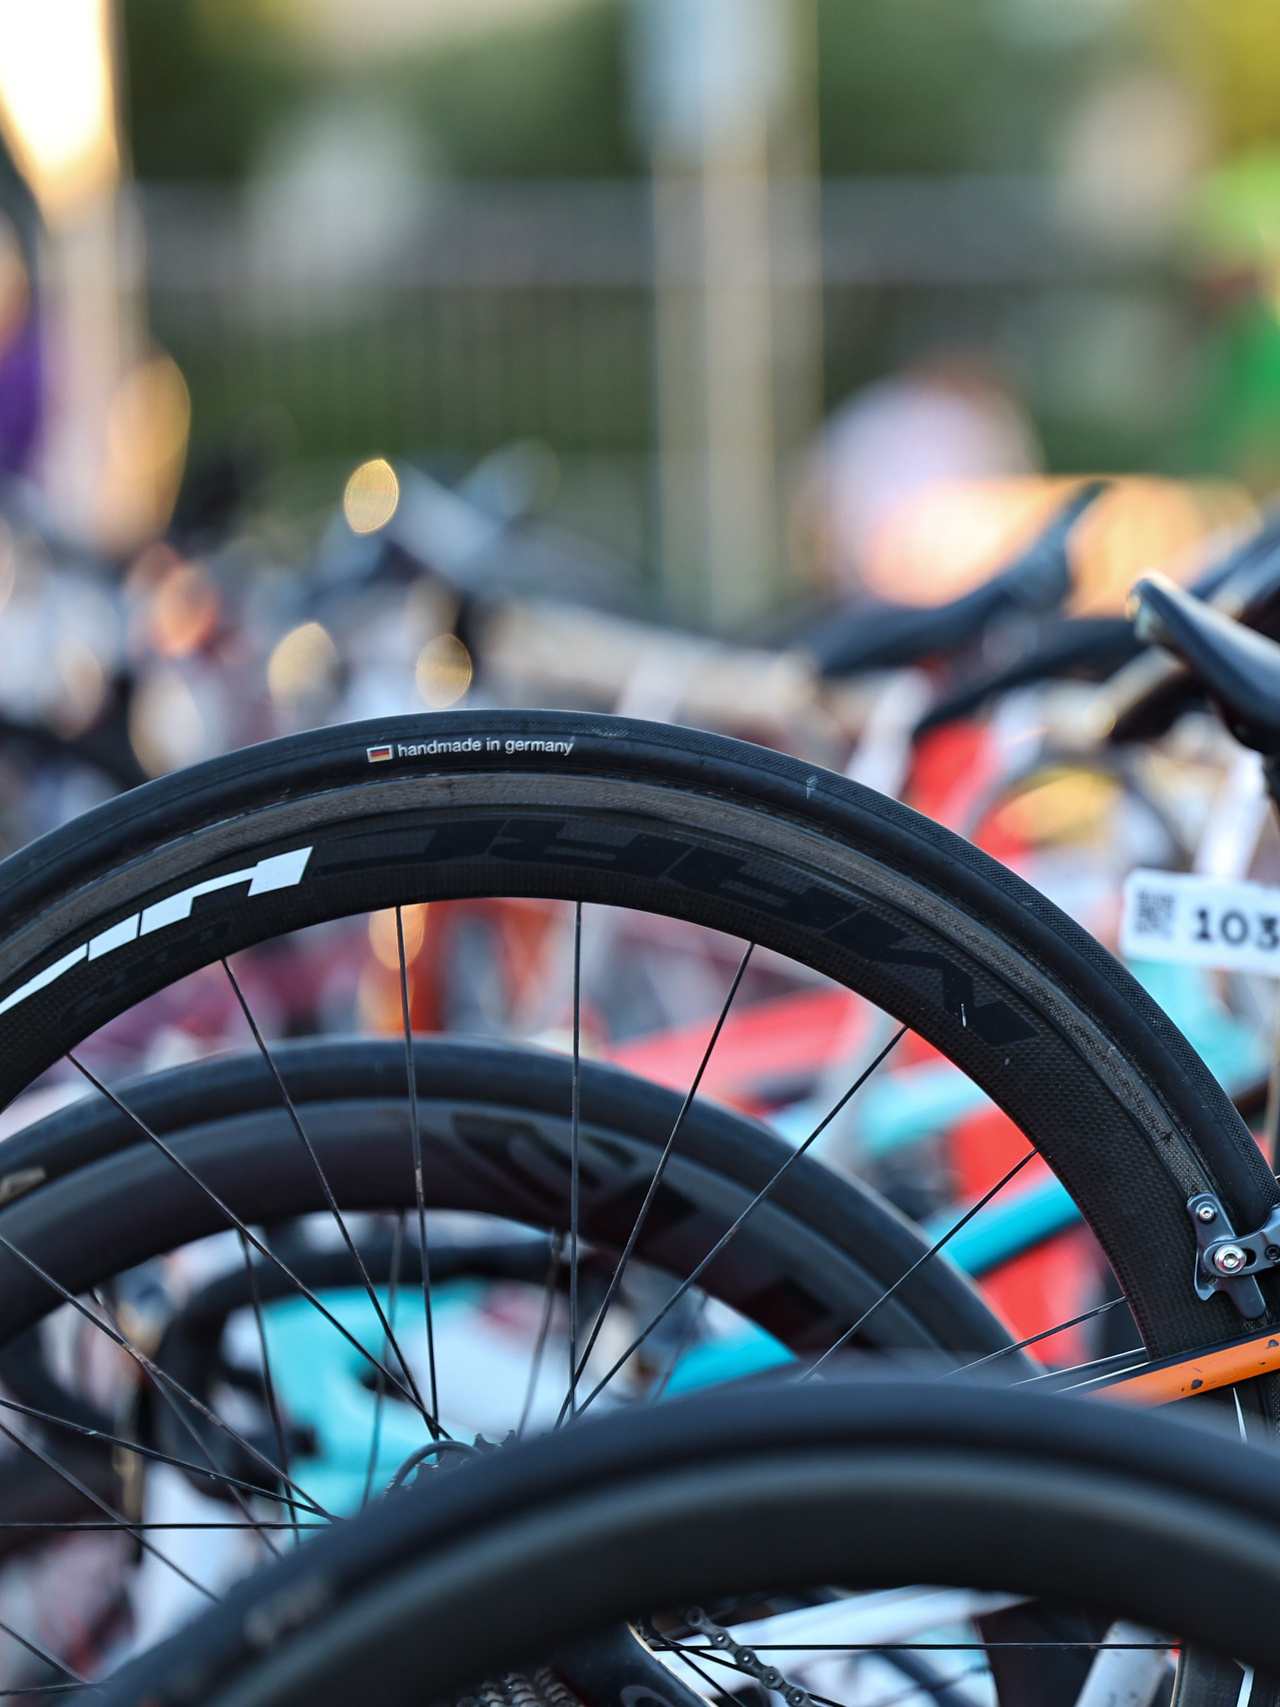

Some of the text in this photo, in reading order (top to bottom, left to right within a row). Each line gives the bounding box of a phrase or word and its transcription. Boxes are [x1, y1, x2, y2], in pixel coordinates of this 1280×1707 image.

[397, 737, 574, 757] handmade in germany
